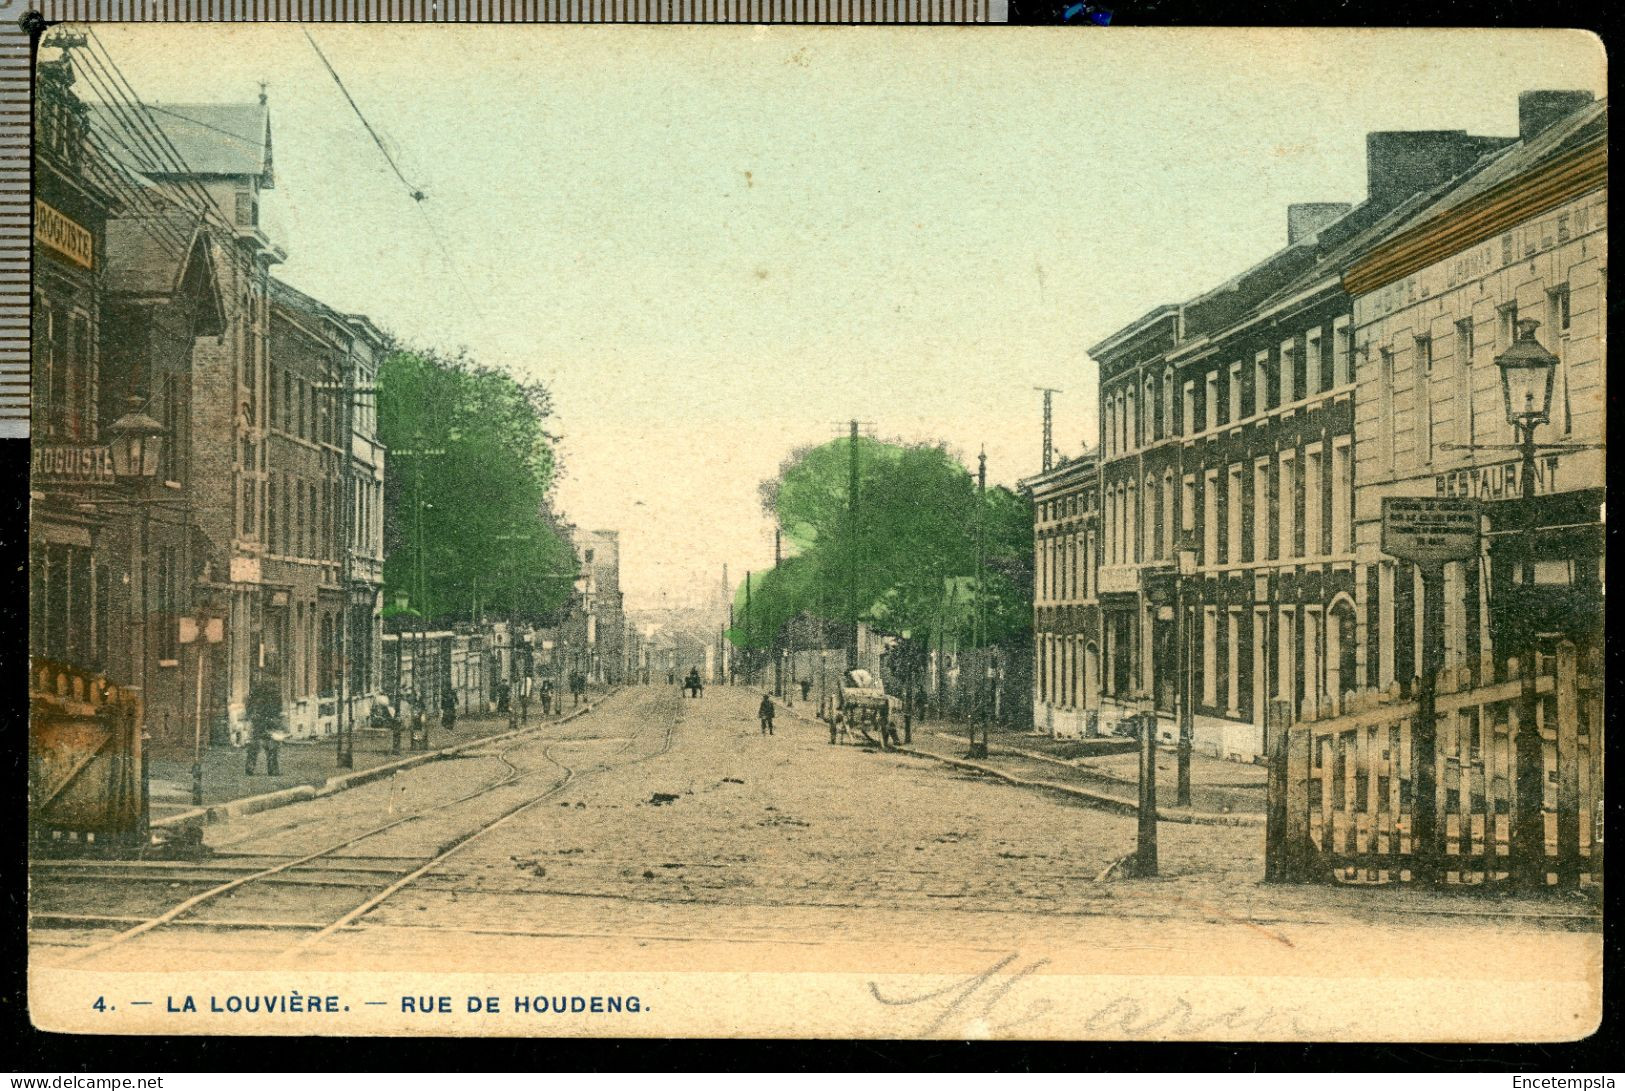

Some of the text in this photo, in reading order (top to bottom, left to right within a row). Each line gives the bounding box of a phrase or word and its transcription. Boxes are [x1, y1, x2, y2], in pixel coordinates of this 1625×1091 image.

[92, 996, 116, 1013] 4.
[167, 996, 197, 1013] LA
[210, 990, 350, 1013] LOUVIÈRE.
[401, 996, 452, 1013] RUE
[467, 996, 500, 1013] DE
[514, 996, 651, 1013] HOUDENG.
